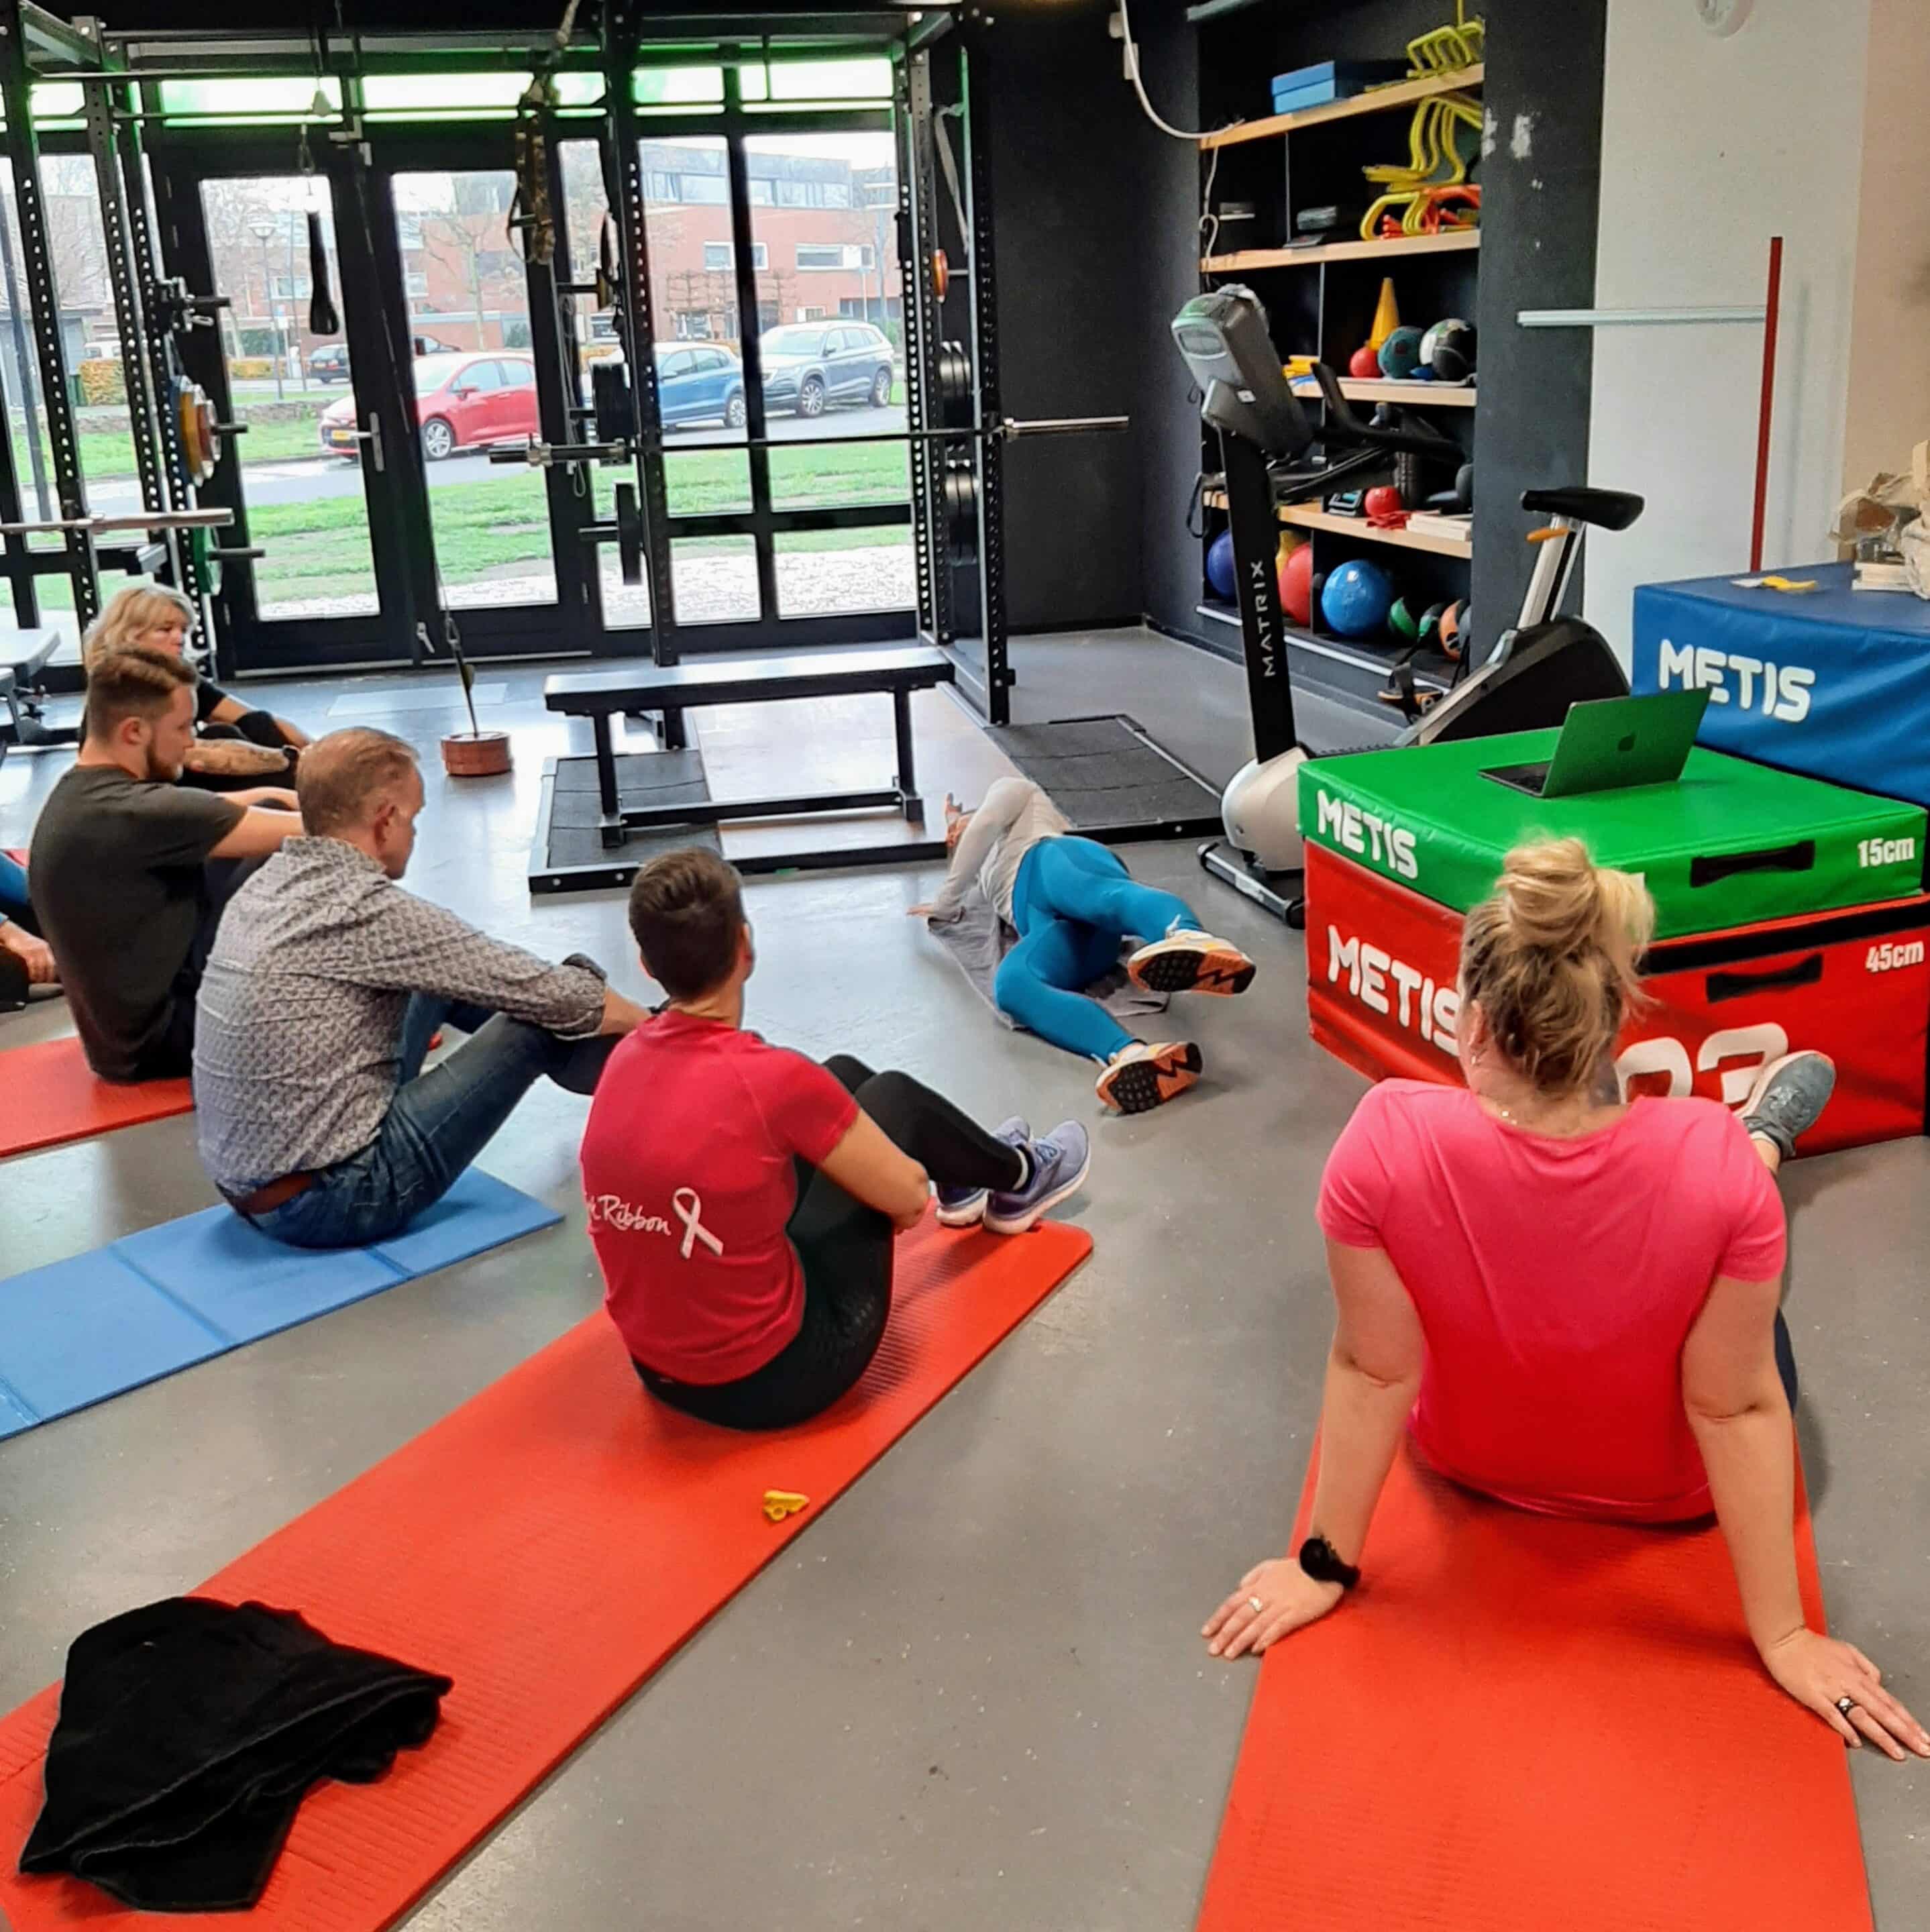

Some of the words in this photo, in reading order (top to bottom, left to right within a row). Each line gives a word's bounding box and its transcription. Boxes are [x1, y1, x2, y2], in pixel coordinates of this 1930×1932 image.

[1250, 559, 1276, 677] MATRIX
[1658, 638, 1816, 722] METIS
[1316, 790, 1418, 879] METIS
[1858, 837, 1915, 868] 15cm
[1328, 924, 1461, 1057] METIS
[1865, 941, 1925, 973] 45cm
[596, 1194, 672, 1236] Ribbon
